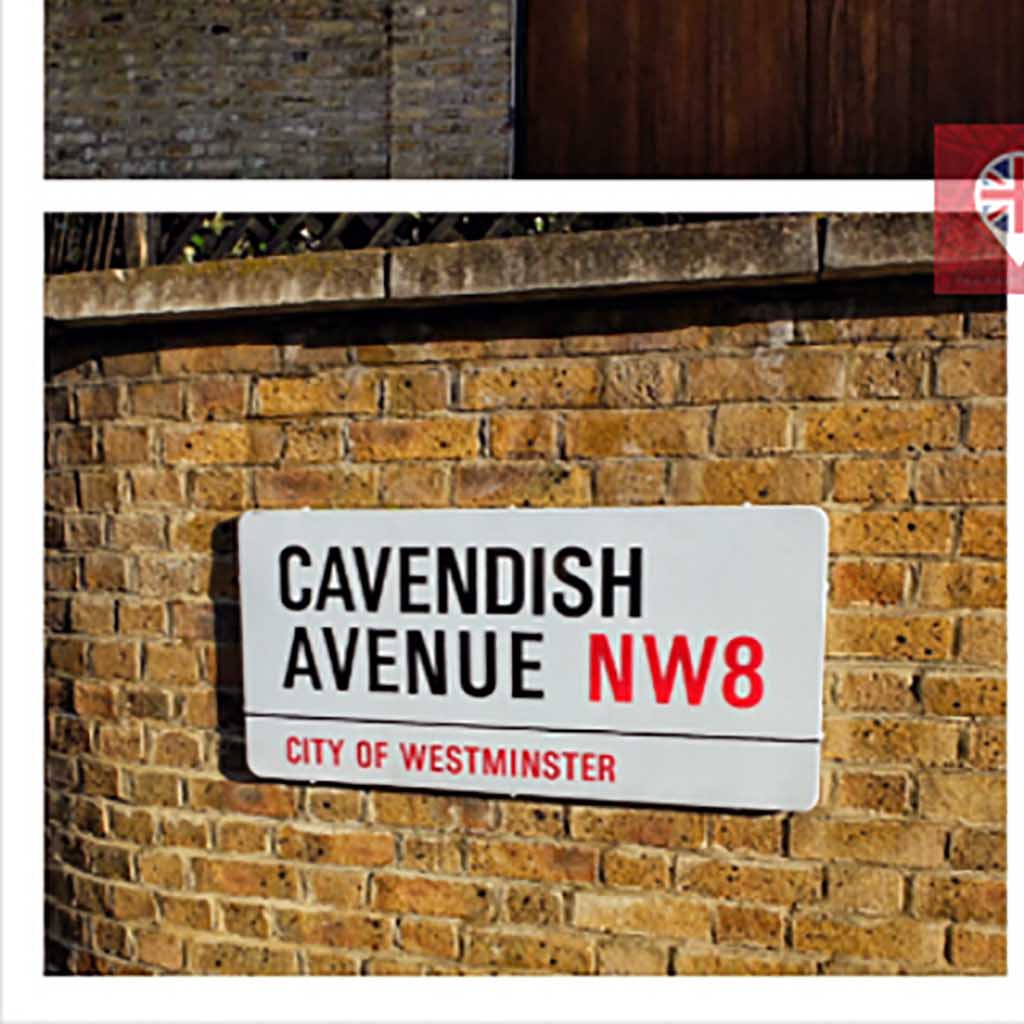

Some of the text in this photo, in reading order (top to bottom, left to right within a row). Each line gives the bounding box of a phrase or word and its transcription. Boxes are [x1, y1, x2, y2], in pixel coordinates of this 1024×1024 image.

[278, 545, 644, 618] CAVENDISH
[282, 626, 765, 709] AVENUE NW8
[286, 736, 616, 783] CITY OF WESTMINSTER
